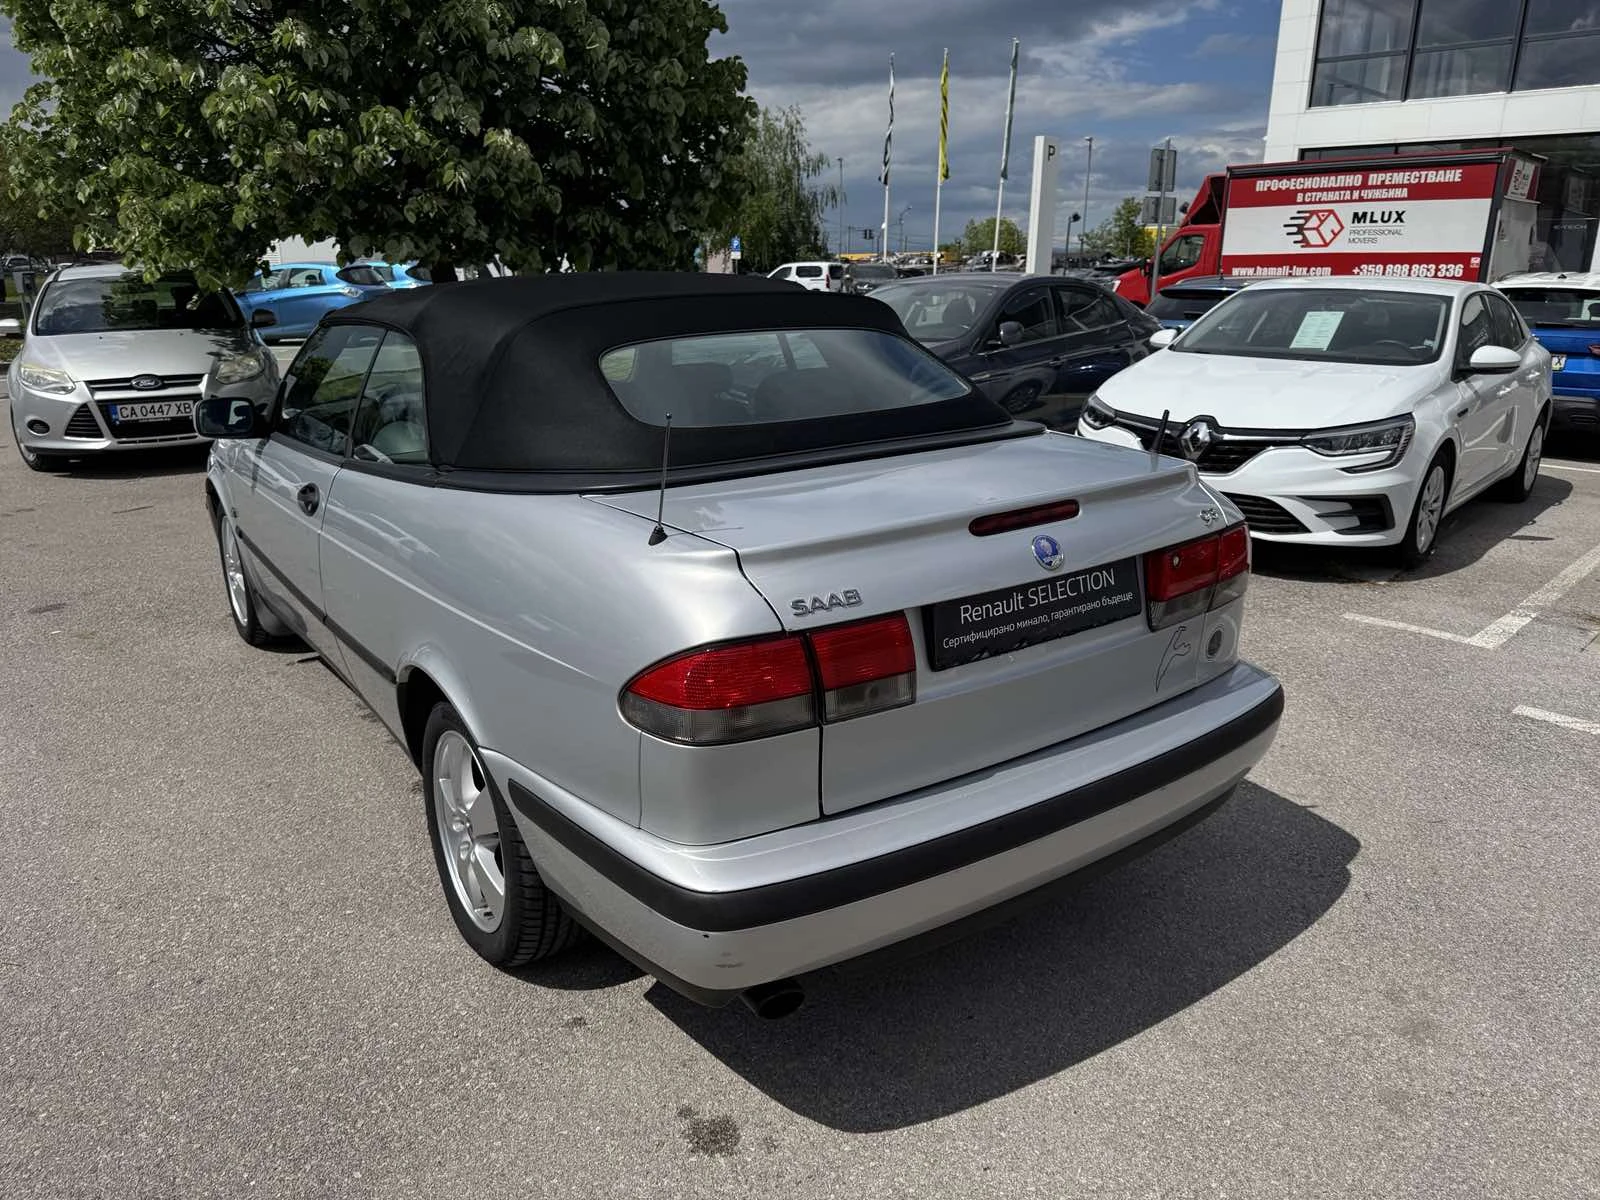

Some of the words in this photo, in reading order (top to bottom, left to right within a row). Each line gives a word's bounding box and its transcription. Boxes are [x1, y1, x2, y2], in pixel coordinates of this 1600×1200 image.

[1048, 145, 1056, 161] P
[1256, 174, 1362, 192] ПРОФЕСИОНАЛНО
[1368, 169, 1463, 186] ПРЕМЕСТВАНЕ
[1296, 192, 1303, 202] В
[1304, 190, 1350, 202] СТРАНАТА
[1352, 189, 1360, 200] И
[1361, 188, 1408, 200] ЧУЖБИНА
[1352, 211, 1406, 224] MLUX
[1349, 228, 1404, 236] PROFESSIONAL
[1231, 265, 1332, 276] www.hamali-lux.com
[1352, 264, 1384, 277] +359
[1385, 264, 1410, 277] 898
[1411, 264, 1436, 277] 863
[1437, 264, 1465, 277] 336
[120, 406, 138, 419] CA
[140, 404, 172, 417] 0447
[790, 589, 863, 616] SAAB
[960, 592, 1024, 625] Renault
[1028, 568, 1115, 607] SELECTION
[943, 623, 1015, 649] Сертифицирано
[1017, 614, 1050, 629] минало,
[1051, 600, 1101, 620] гарантирано
[1101, 591, 1134, 606] бъдеще
